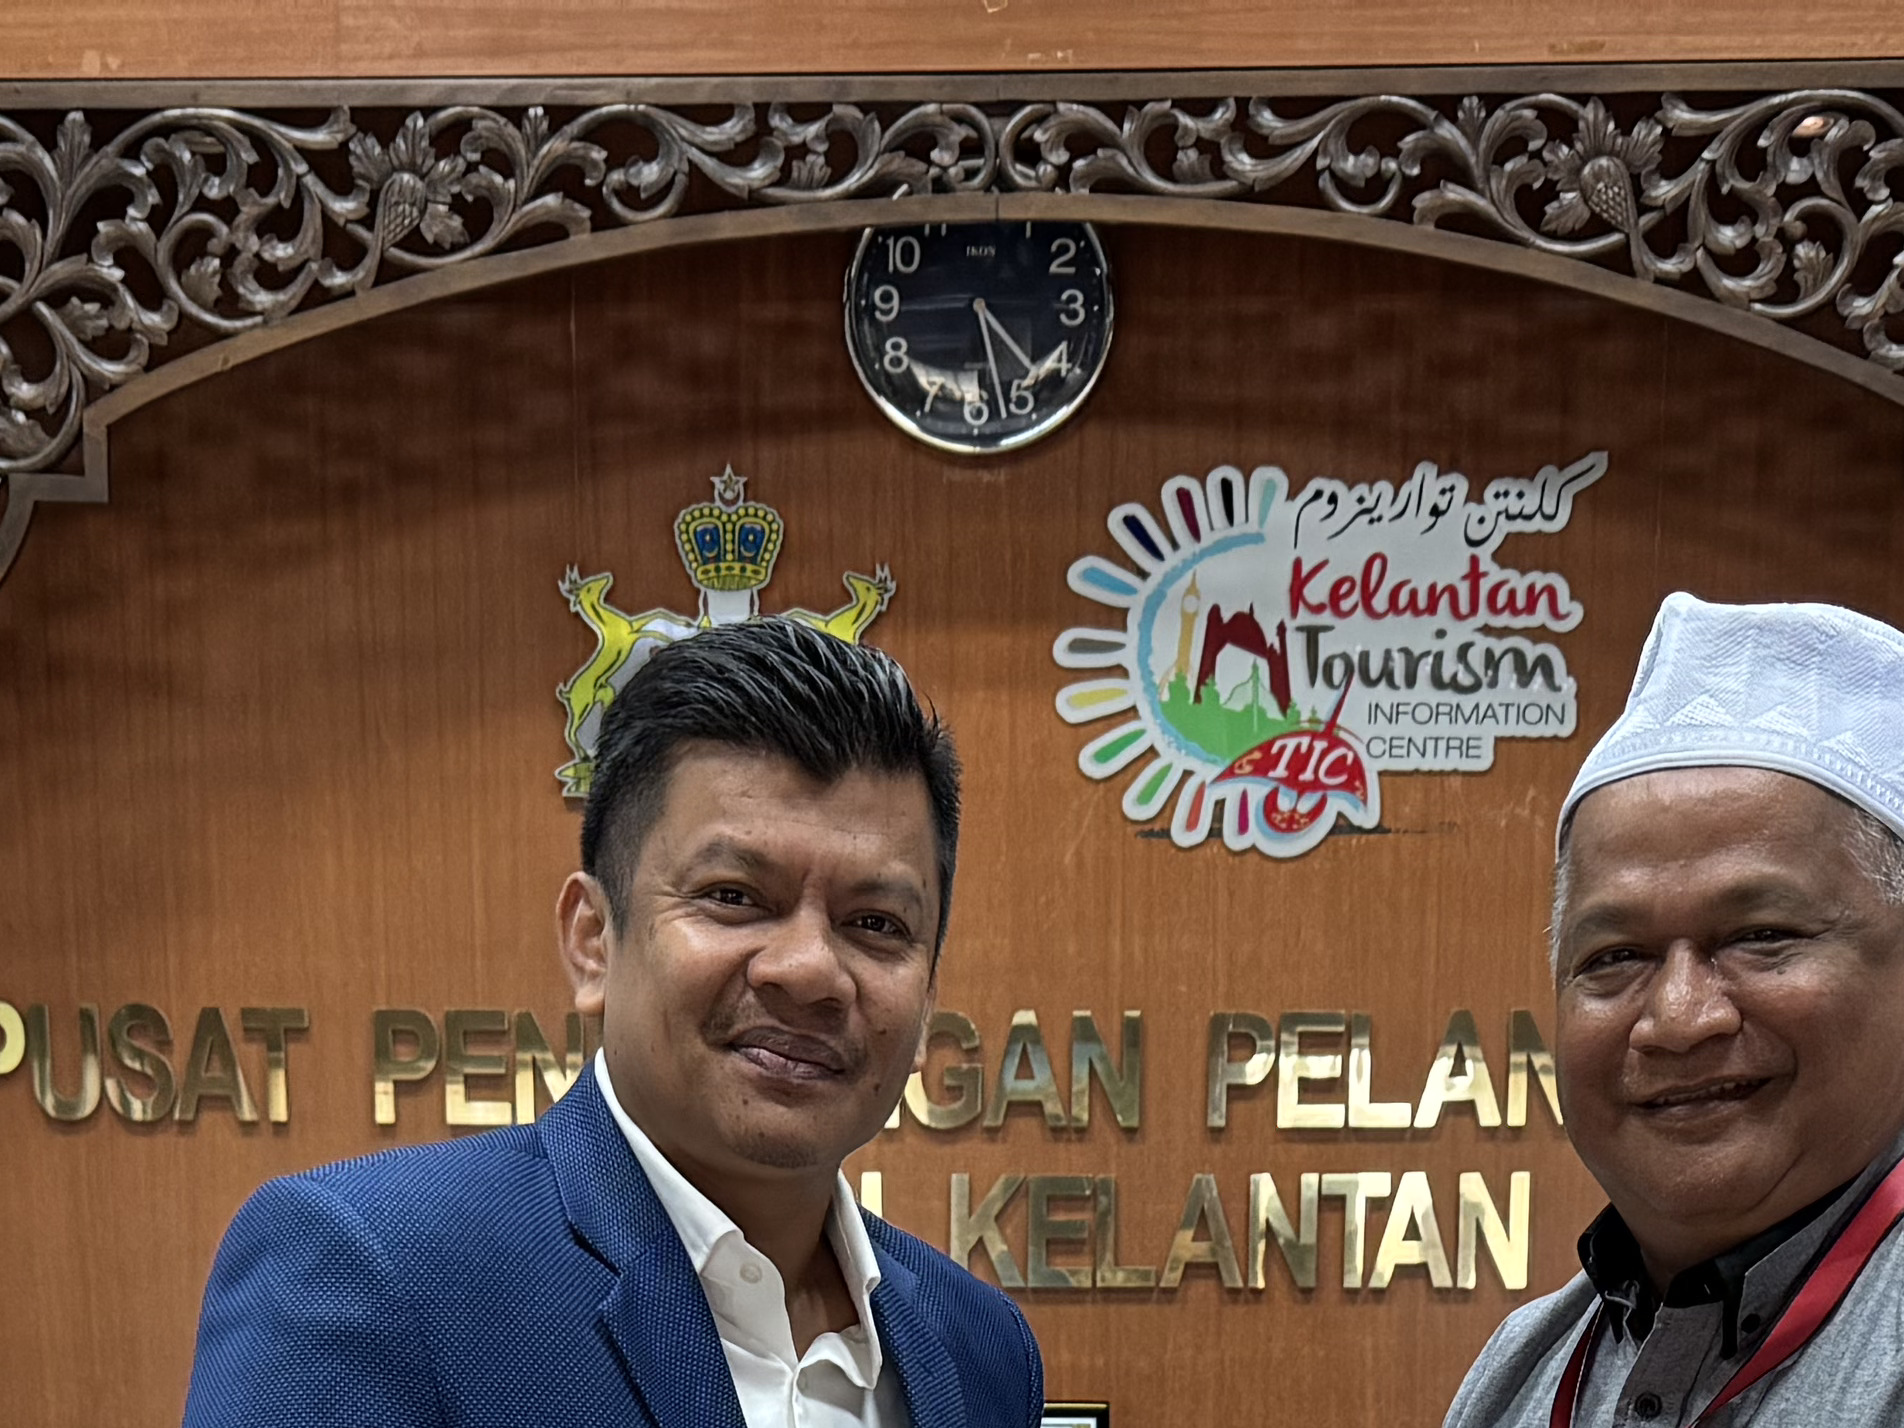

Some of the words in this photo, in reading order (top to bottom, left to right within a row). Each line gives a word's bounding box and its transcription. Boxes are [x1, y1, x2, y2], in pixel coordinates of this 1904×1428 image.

[886, 236, 921, 274] 10
[1049, 238, 1076, 274] 2
[874, 285, 899, 321] 9
[1059, 289, 1085, 326] 3
[883, 337, 909, 373] 8
[1043, 340, 1072, 377] 4
[964, 388, 989, 425] 6
[1009, 379, 1034, 414] 5
[1289, 552, 1571, 621] Kelantan
[1295, 625, 1563, 692] Tourism
[1367, 702, 1566, 726] INFORMATION
[1268, 738, 1353, 786] TIC
[1366, 737, 1482, 759] CENTRE
[952, 1172, 1530, 1290] KELANTAN
